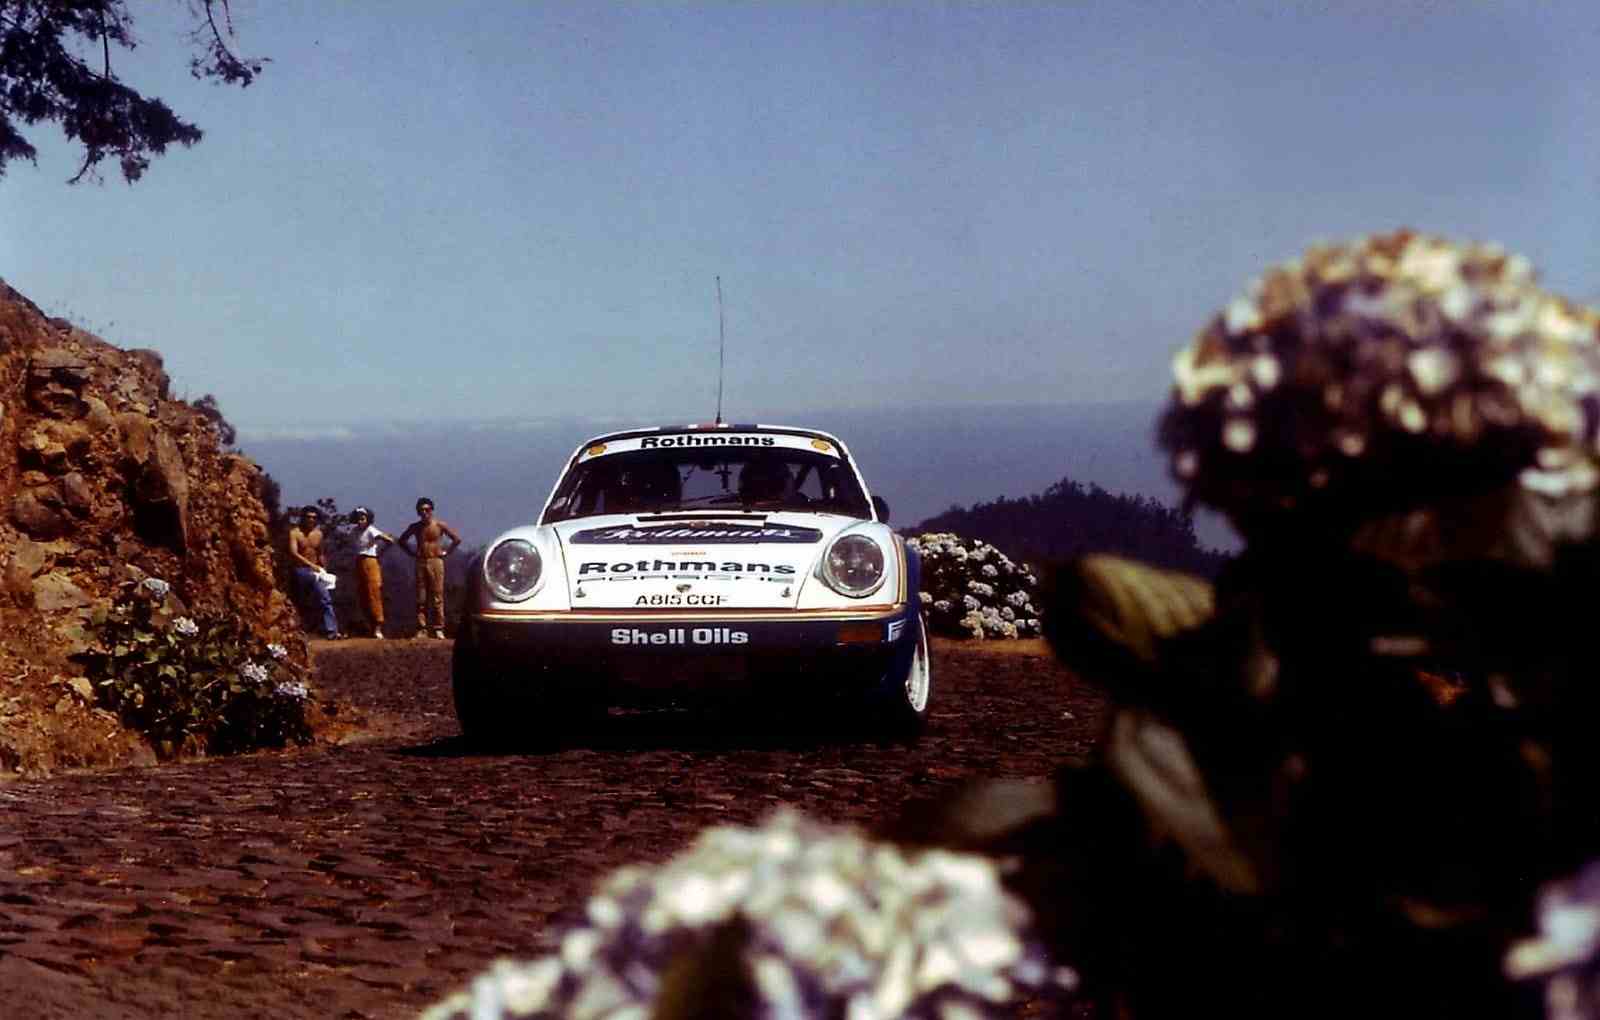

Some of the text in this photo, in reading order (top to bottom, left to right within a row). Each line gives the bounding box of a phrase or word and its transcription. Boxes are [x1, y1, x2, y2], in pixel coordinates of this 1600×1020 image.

[641, 435, 775, 449] Rothmans
[578, 559, 796, 575] Rothmans
[635, 594, 682, 606] A815
[611, 628, 749, 645] Shell Oils
